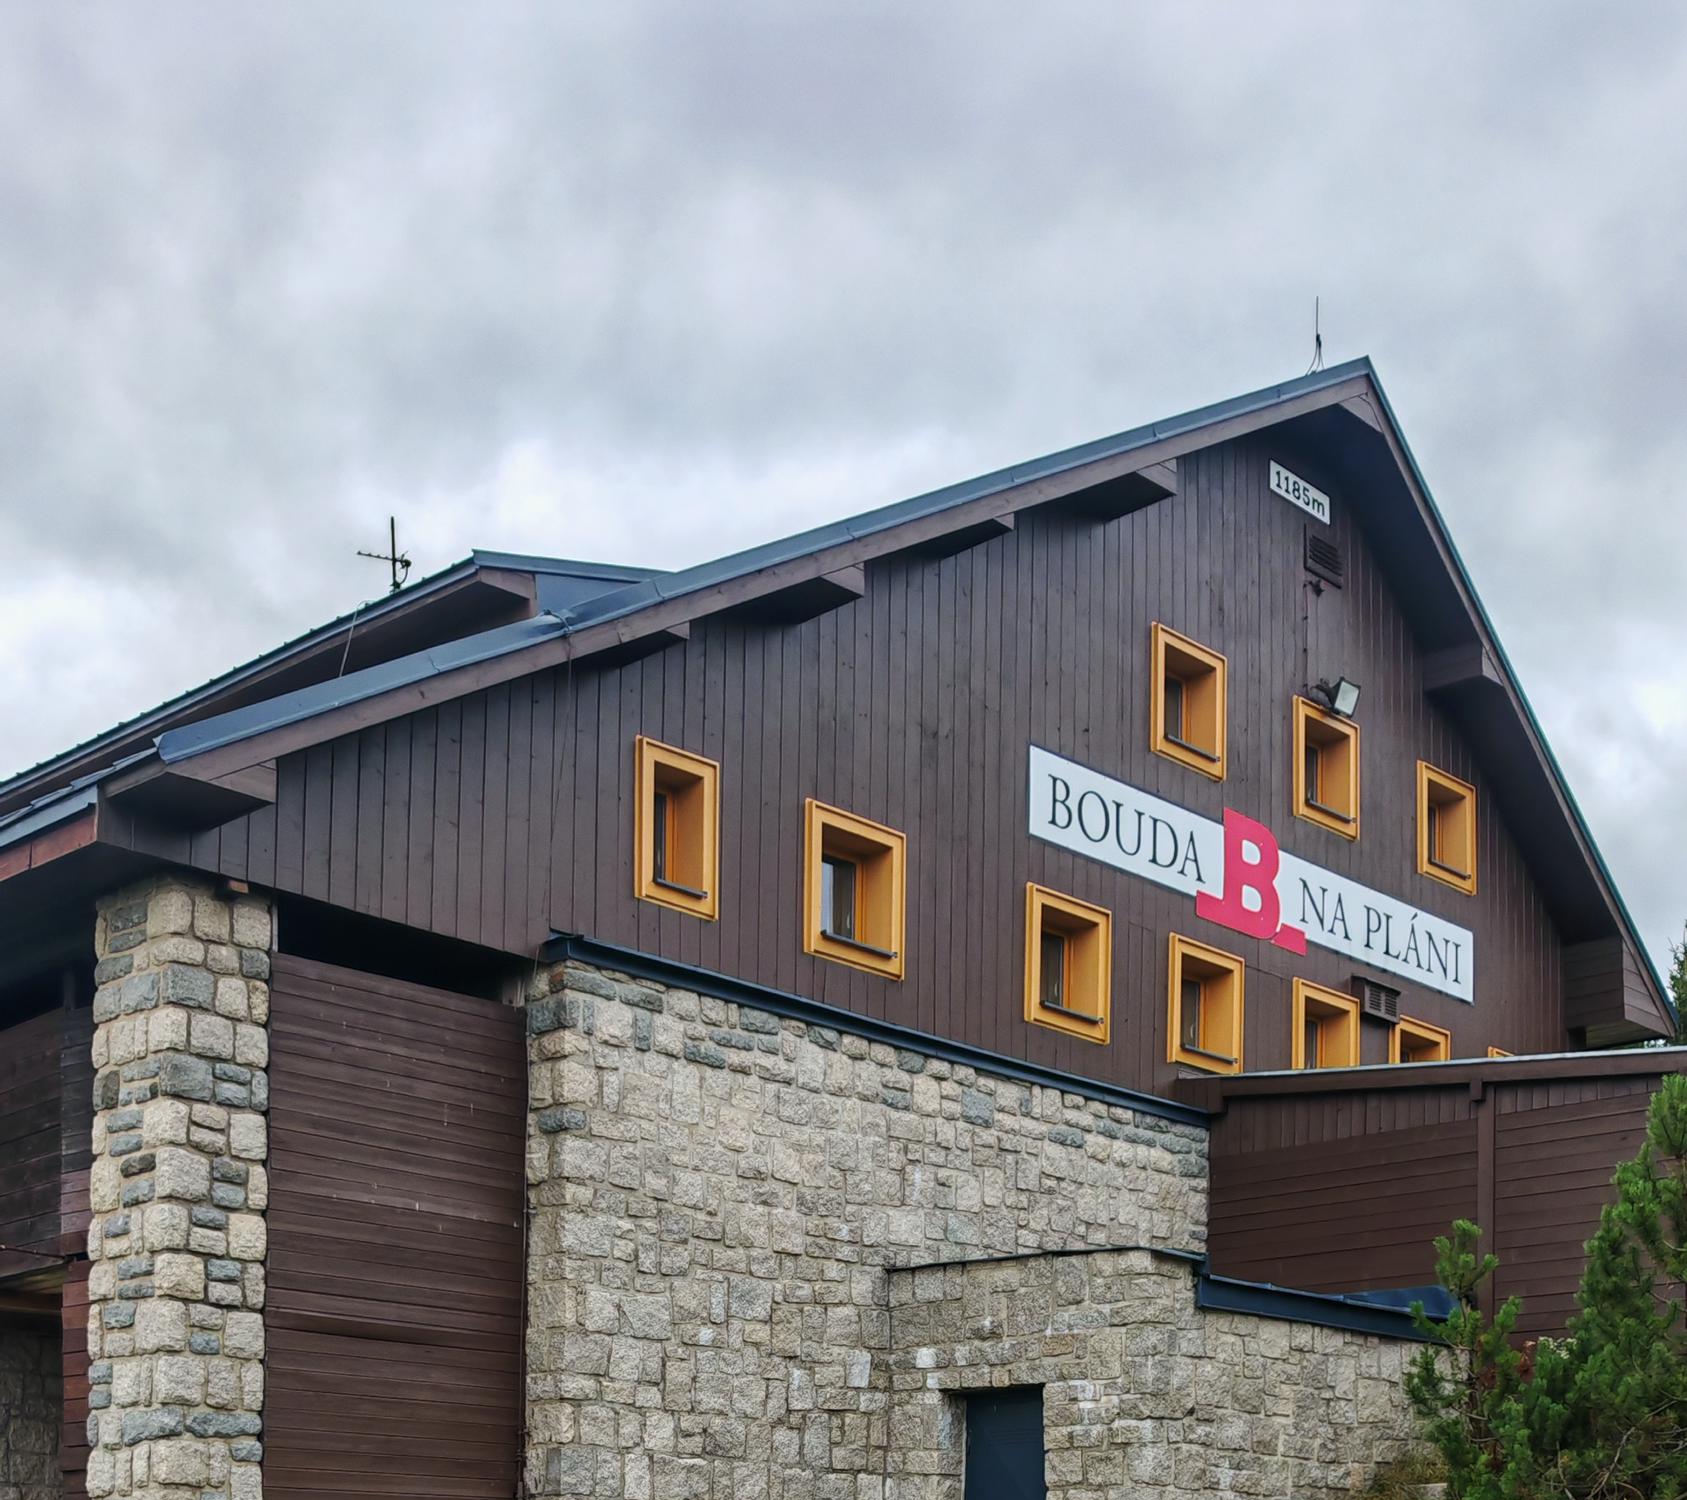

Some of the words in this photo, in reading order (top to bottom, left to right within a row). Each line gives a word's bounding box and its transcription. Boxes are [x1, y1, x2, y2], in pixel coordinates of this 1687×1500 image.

[1275, 469, 1325, 517] 1185m
[1047, 773, 1206, 884] BOUDA
[1196, 806, 1307, 956] B
[1299, 876, 1352, 942] NA
[1363, 912, 1463, 984] PLÁNI
